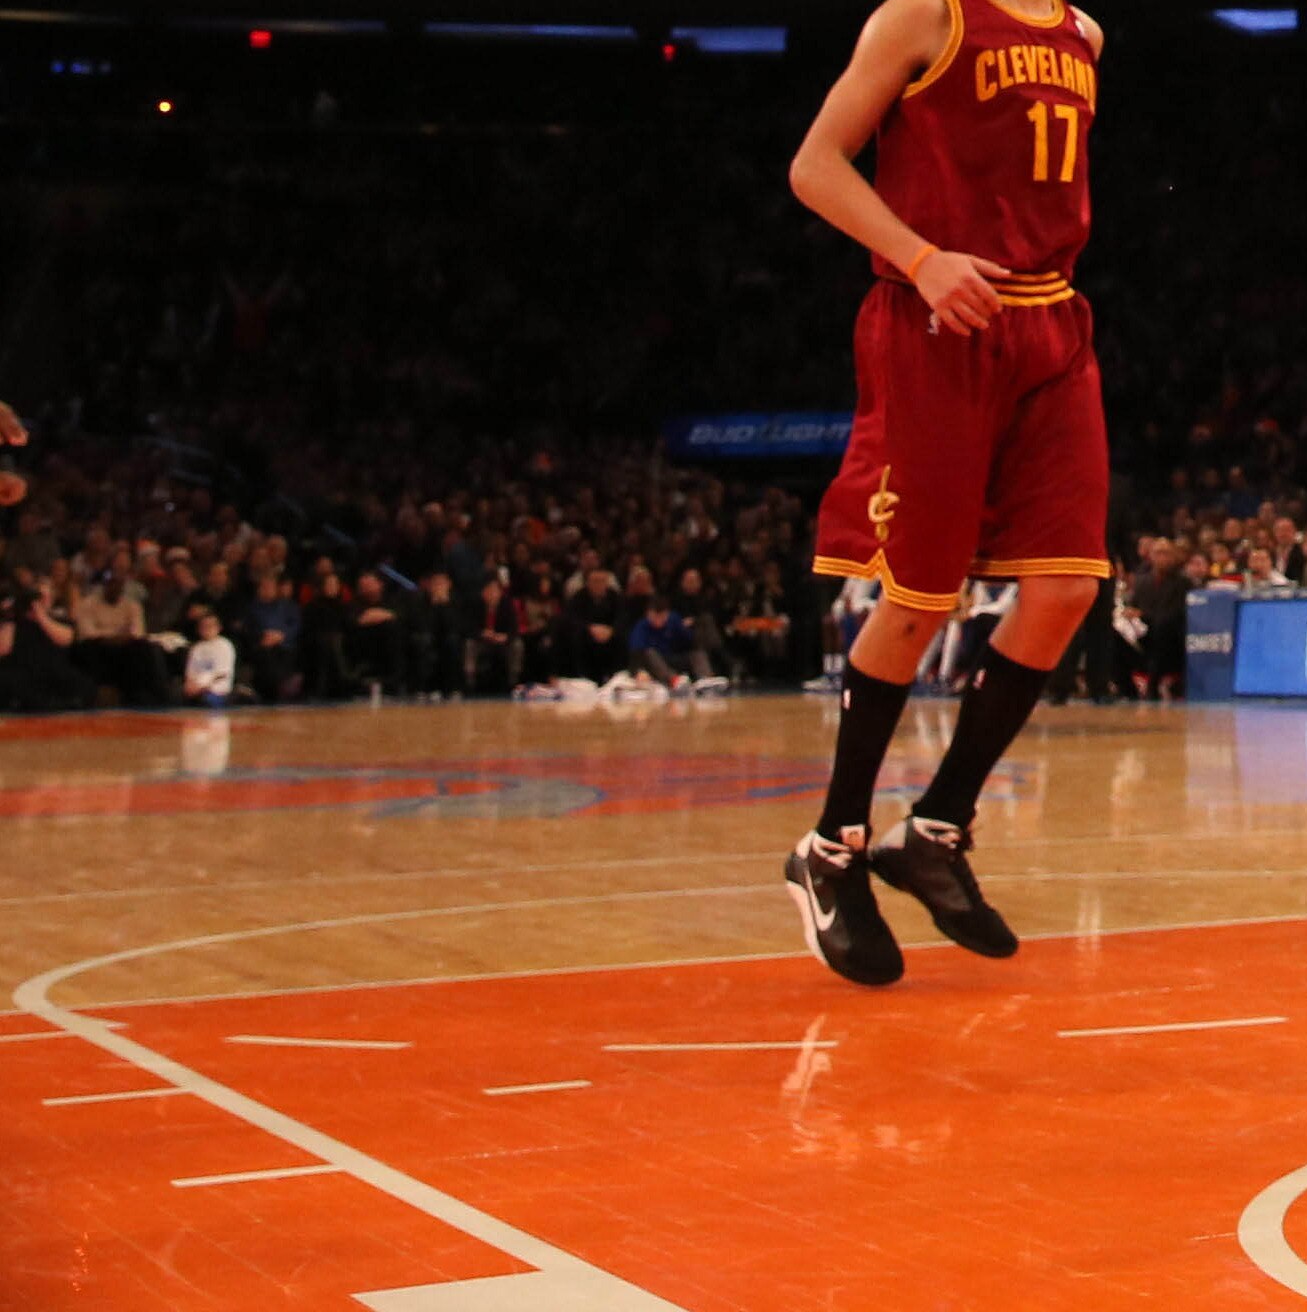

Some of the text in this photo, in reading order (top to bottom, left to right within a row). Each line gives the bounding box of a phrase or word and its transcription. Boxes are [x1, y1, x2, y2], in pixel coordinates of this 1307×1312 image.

[974, 44, 1098, 116] CLEVELAND
[1027, 100, 1079, 183] 17
[688, 423, 756, 445] BUD
